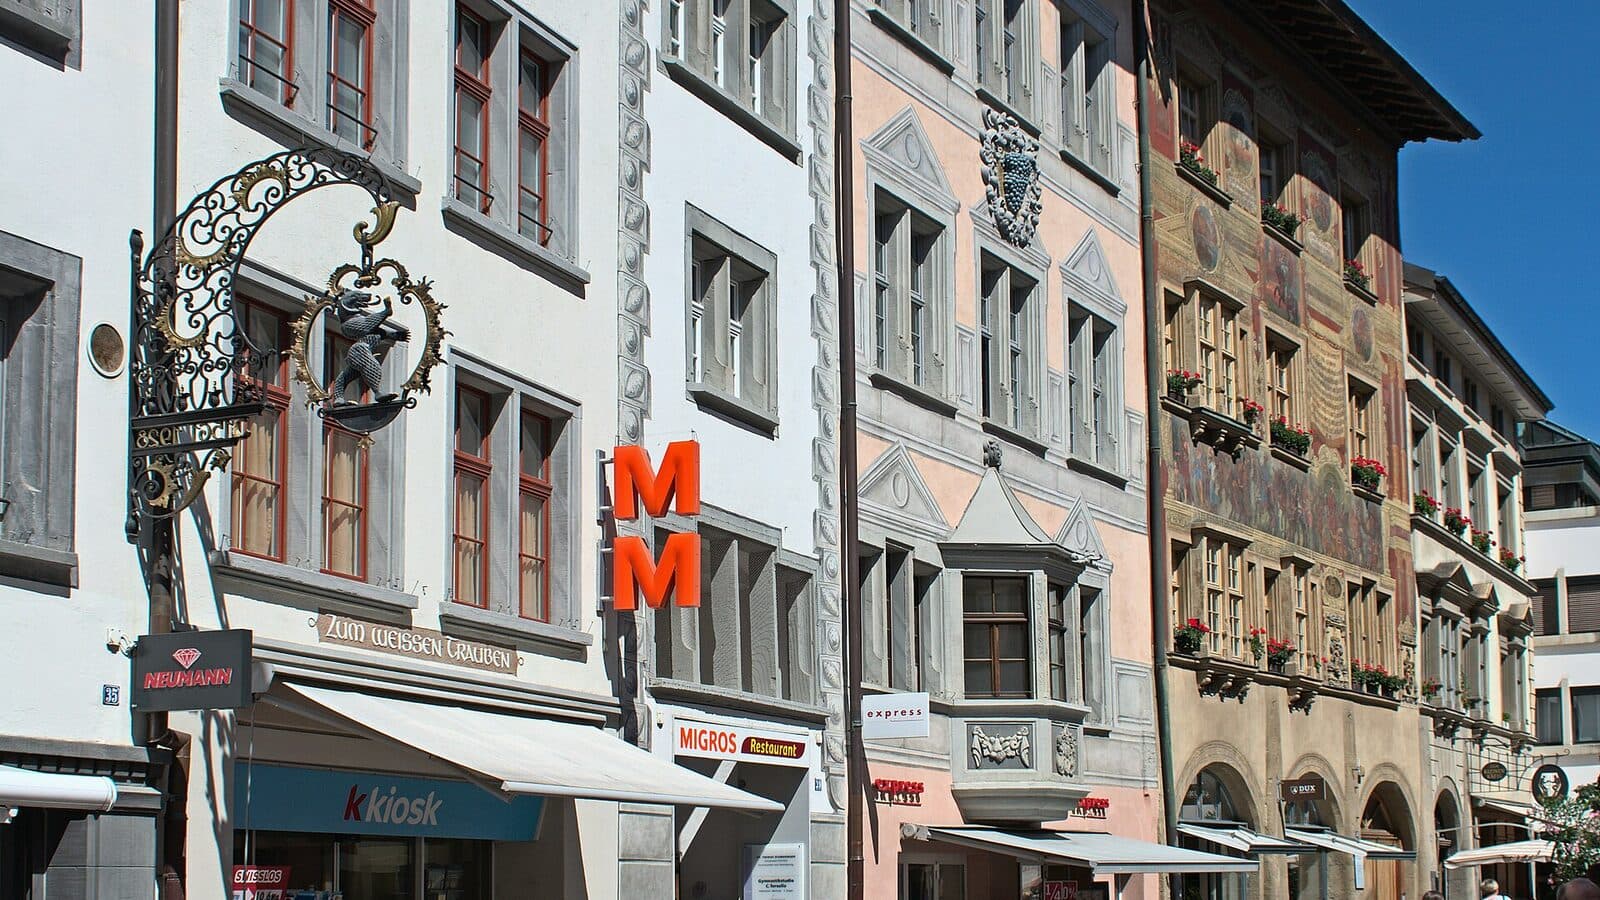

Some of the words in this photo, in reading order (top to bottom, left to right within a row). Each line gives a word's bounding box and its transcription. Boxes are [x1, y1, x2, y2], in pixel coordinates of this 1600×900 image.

[613, 440, 700, 521] M
[613, 532, 701, 611] M
[143, 667, 233, 689] NEUMANN
[105, 687, 119, 704] 35
[867, 708, 922, 719] express
[680, 727, 737, 754] MIGROS
[750, 738, 797, 757] Restaurant
